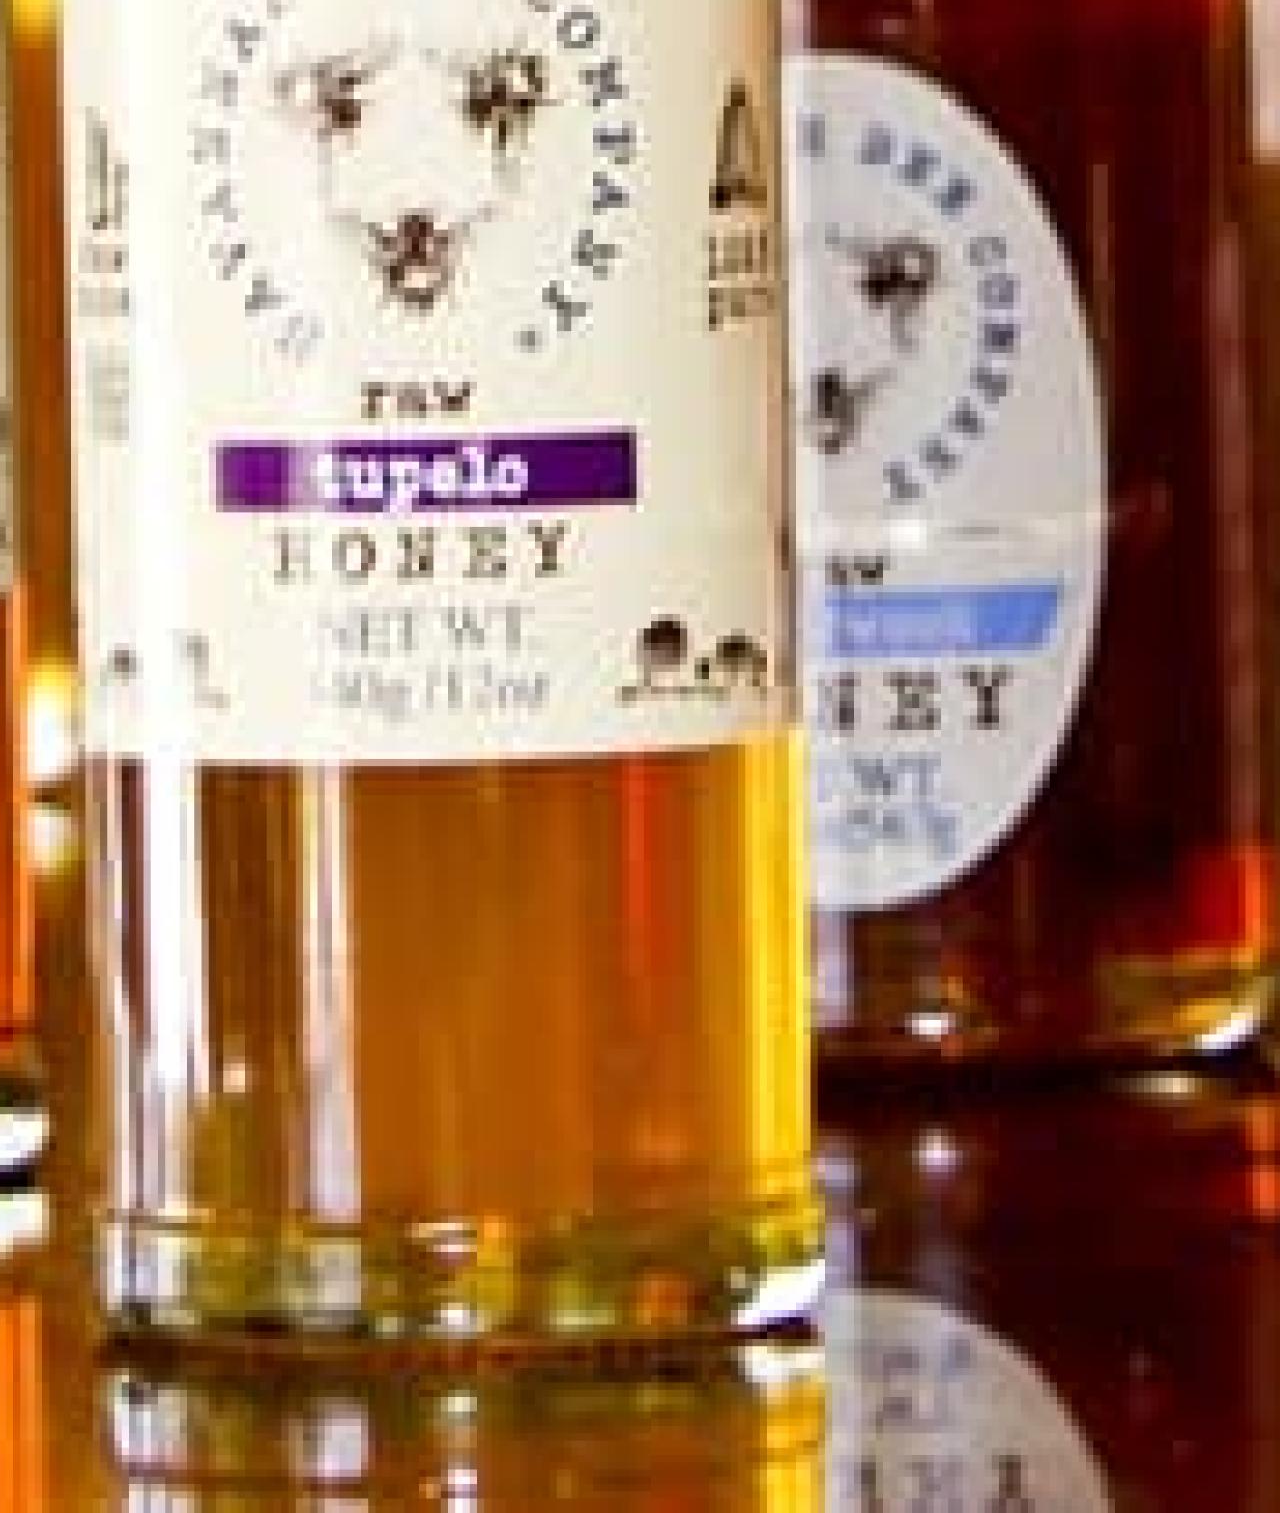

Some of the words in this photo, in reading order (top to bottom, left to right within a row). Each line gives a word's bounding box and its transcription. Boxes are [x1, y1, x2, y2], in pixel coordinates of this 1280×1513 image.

[360, 380, 475, 418] raw
[310, 447, 530, 515] tupelo
[274, 523, 572, 580] HONEY
[816, 665, 1014, 733] NEY
